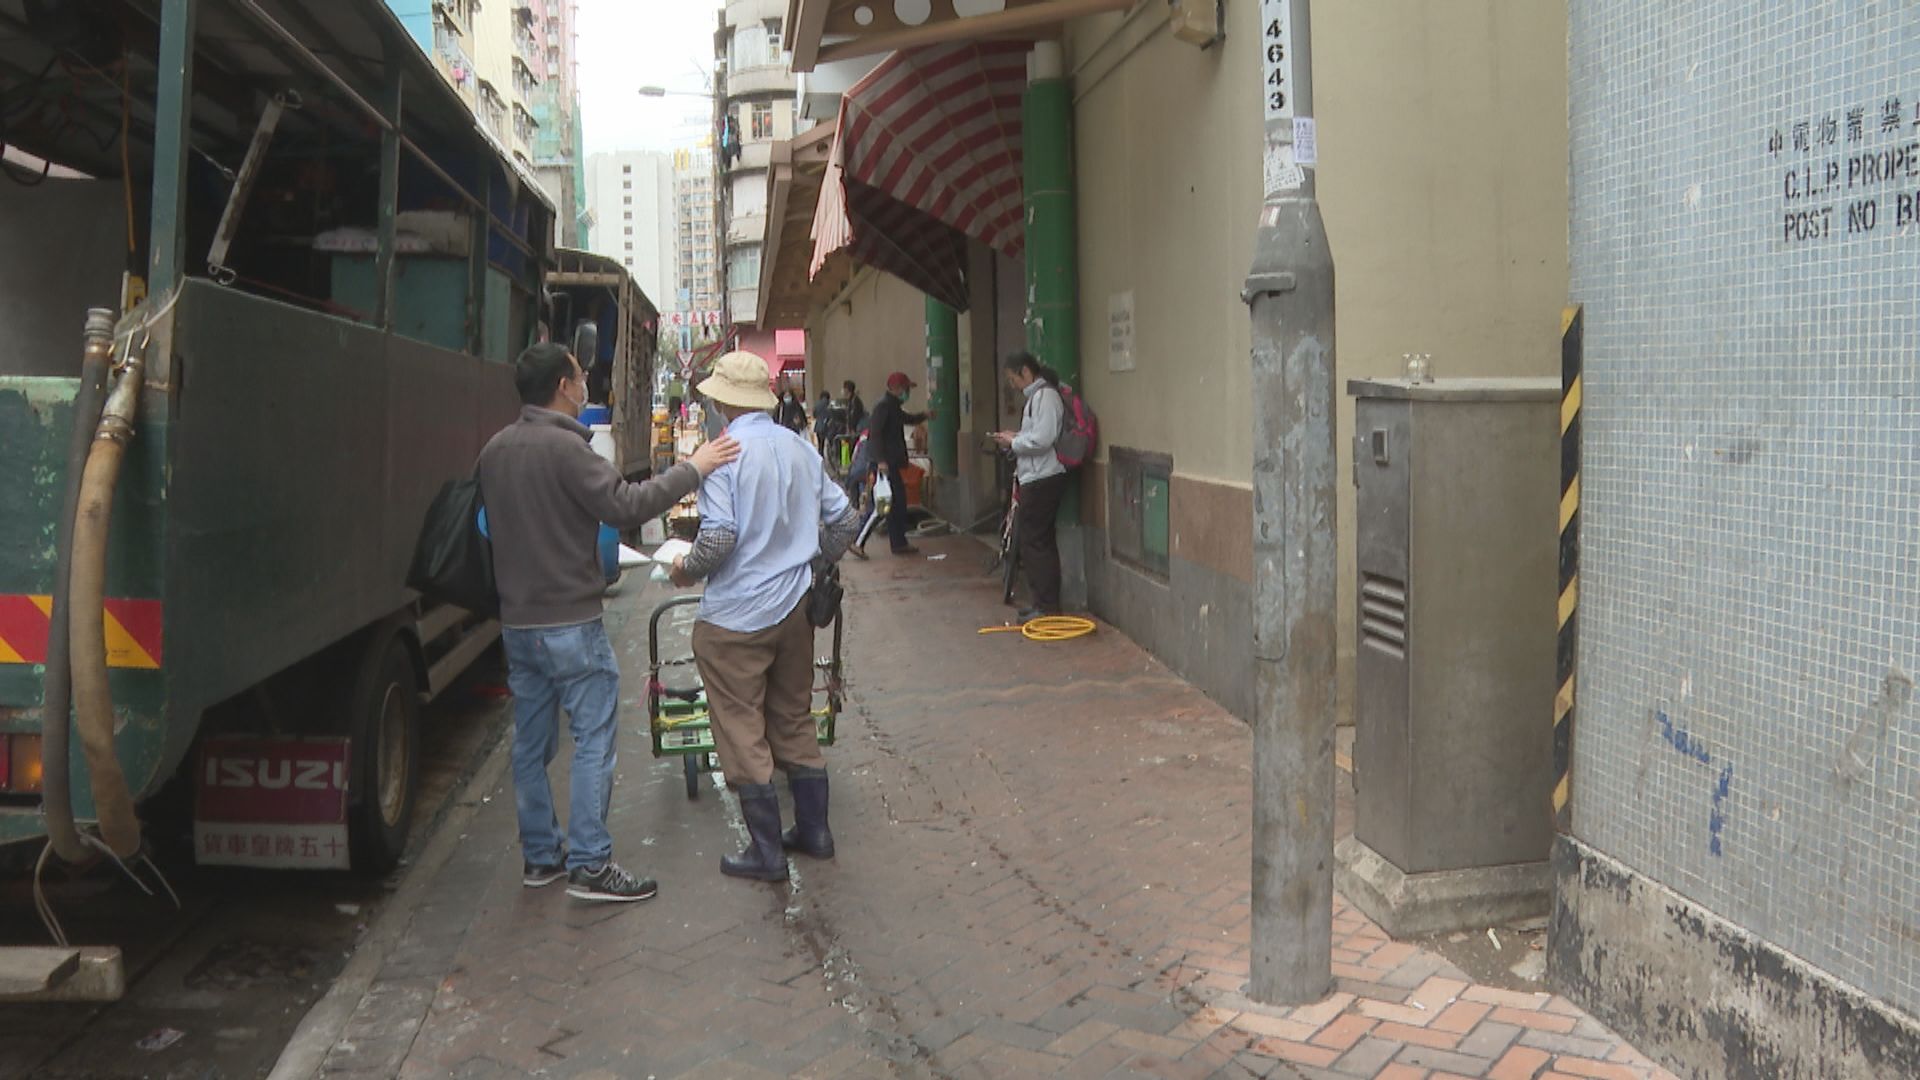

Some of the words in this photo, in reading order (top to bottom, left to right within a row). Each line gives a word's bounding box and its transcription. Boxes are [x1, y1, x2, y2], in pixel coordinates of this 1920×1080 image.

[1266, 18, 1284, 110] 4643
[1784, 206, 1833, 243] POST
[1849, 199, 1876, 233] NO
